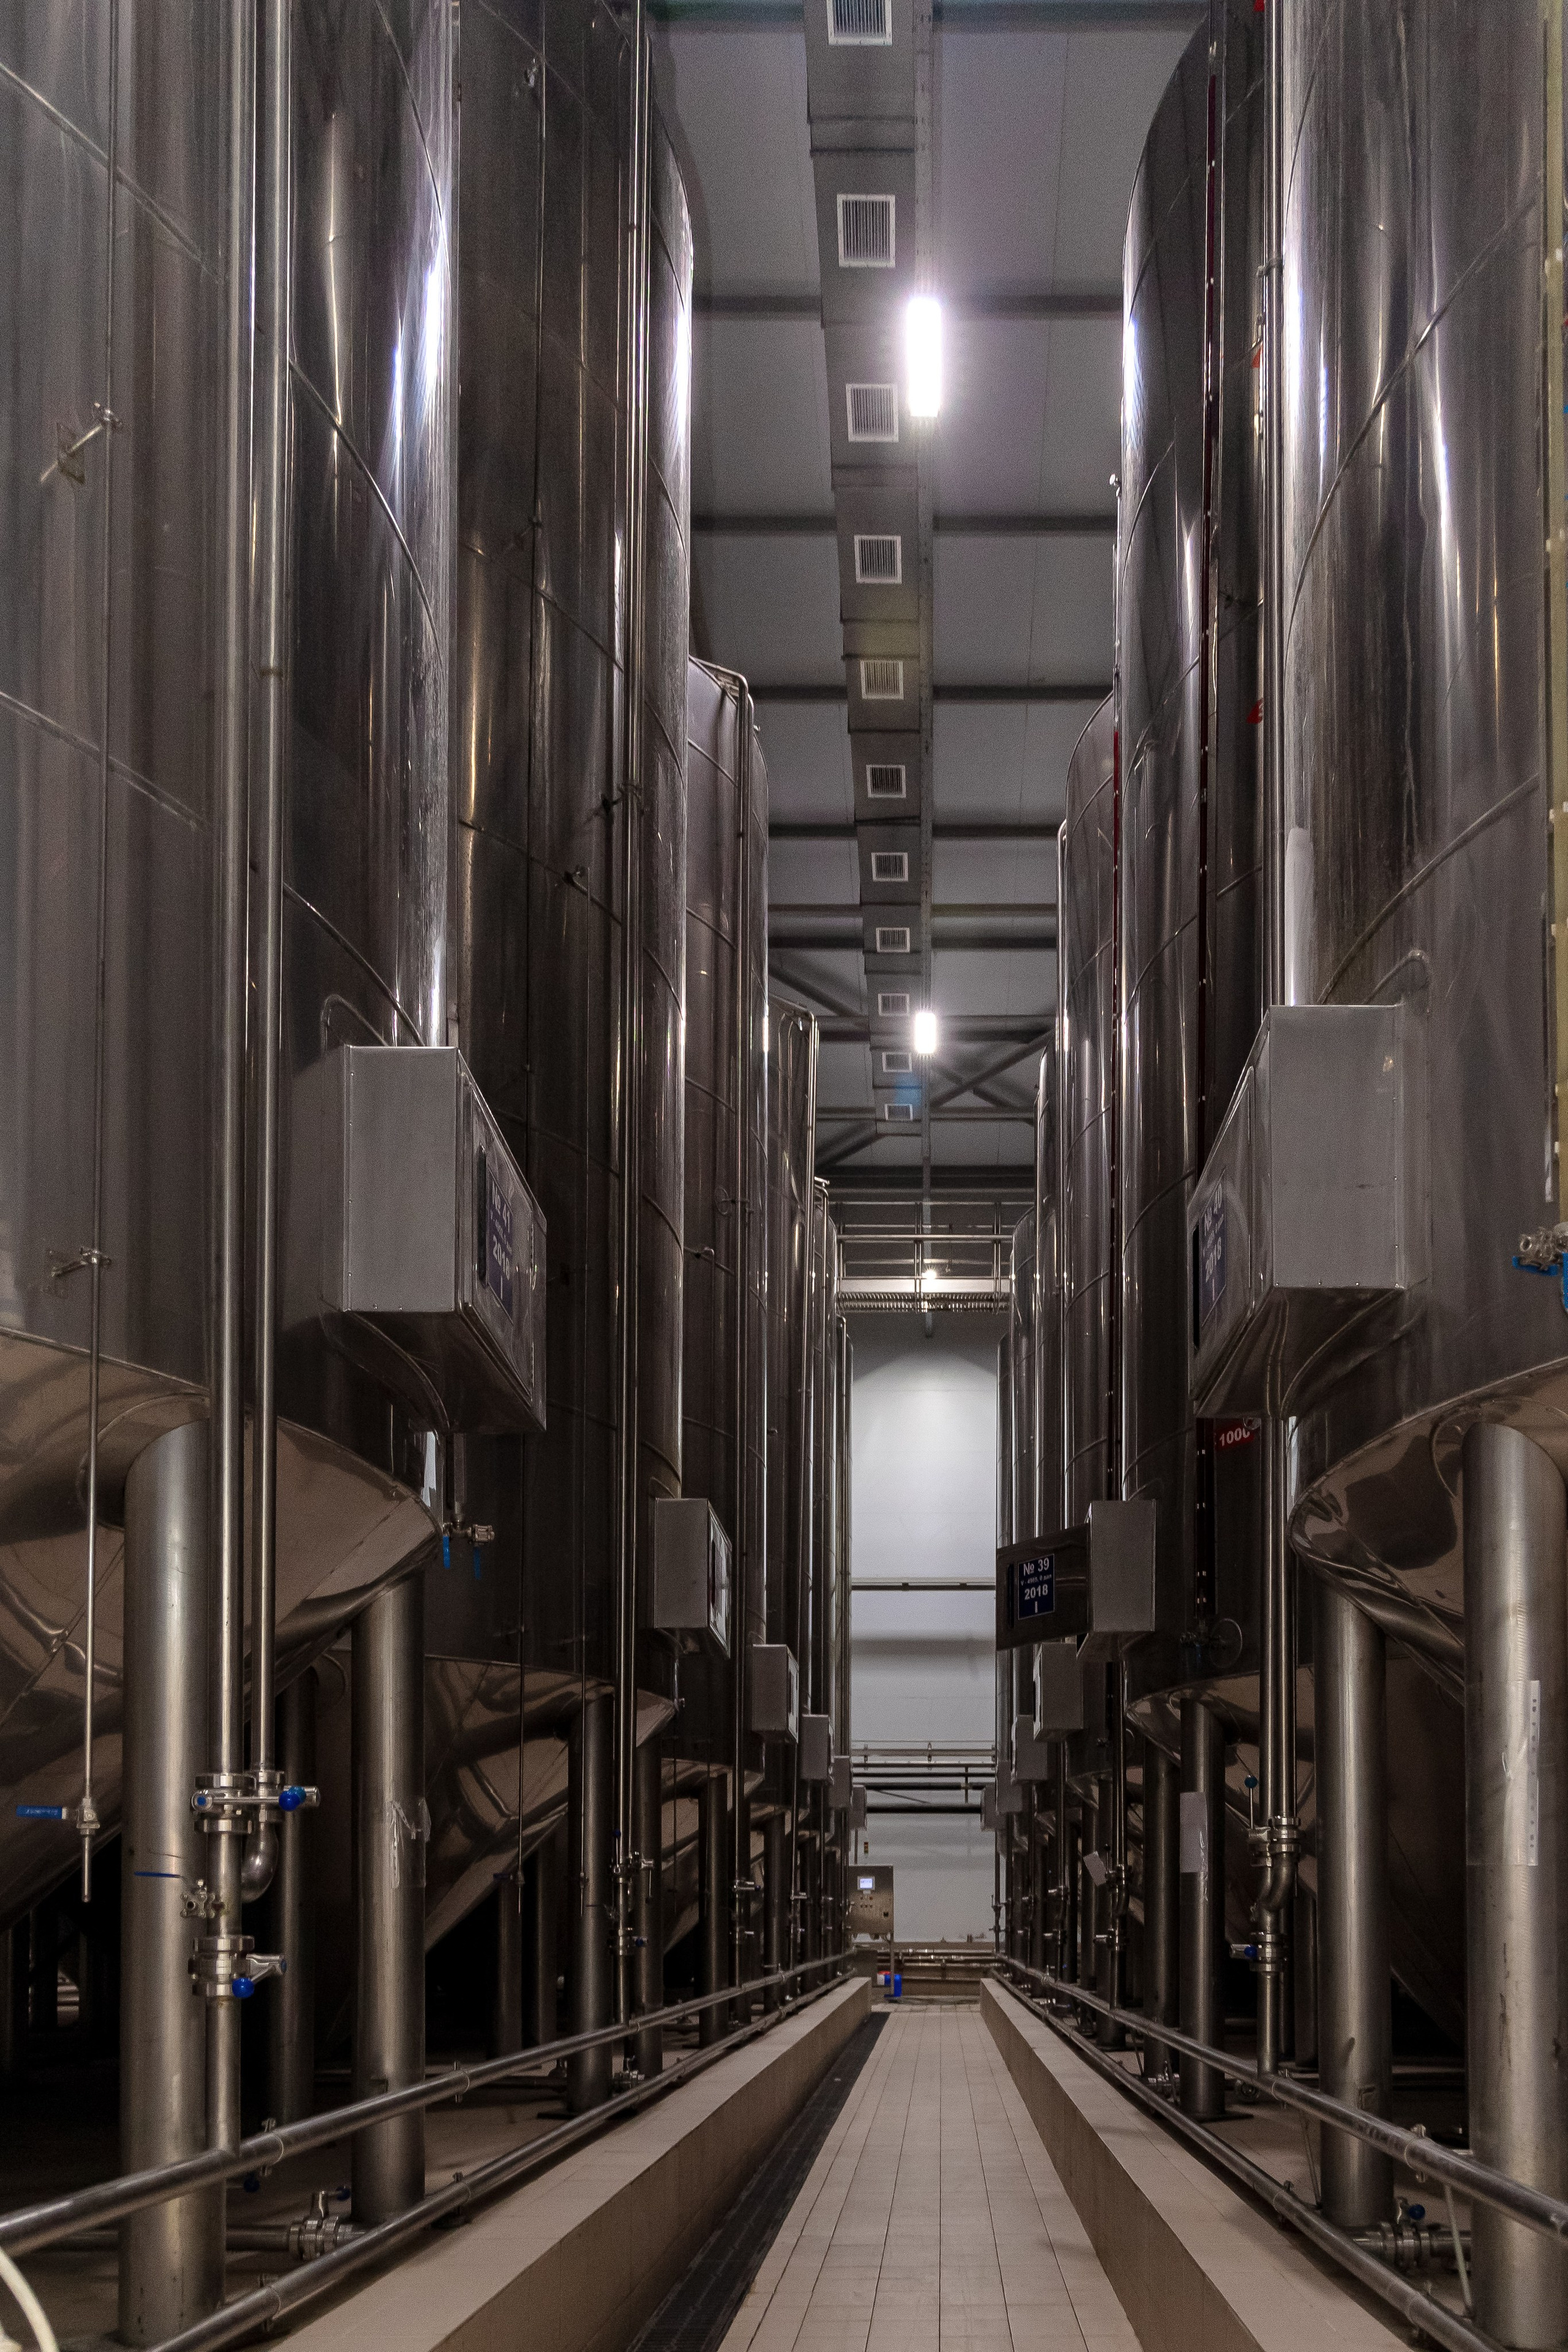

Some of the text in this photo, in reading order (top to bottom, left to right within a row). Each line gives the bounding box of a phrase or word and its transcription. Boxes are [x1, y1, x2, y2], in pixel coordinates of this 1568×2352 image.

[492, 1180, 510, 1232] № 41
[1204, 1183, 1222, 1236] № 40
[492, 1234, 510, 1280] 2018
[1205, 1237, 1221, 1283] 2018
[1023, 1558, 1049, 1577] № 39
[1024, 1584, 1049, 1600] 2018
